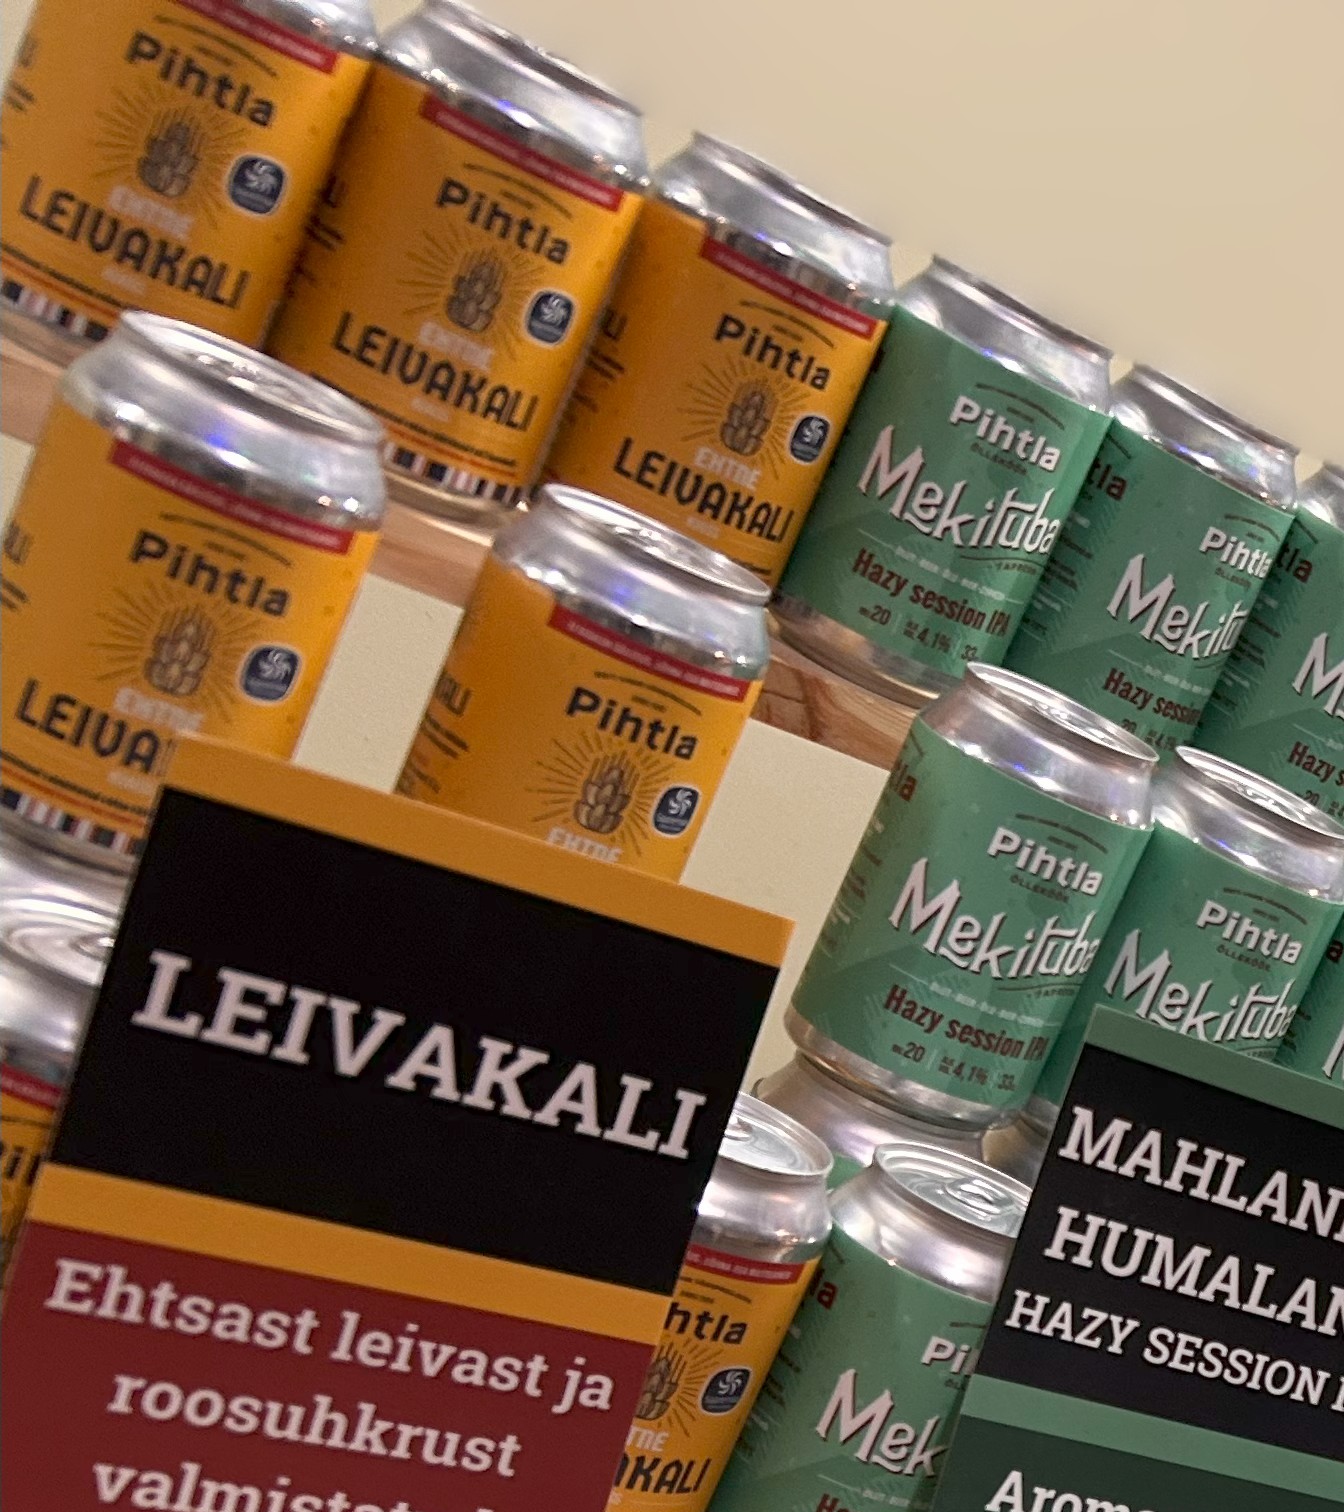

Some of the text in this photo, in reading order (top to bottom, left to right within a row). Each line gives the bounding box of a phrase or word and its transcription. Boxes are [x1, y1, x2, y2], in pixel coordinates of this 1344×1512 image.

[124, 29, 278, 128] Pihtla
[17, 172, 251, 311] LEIVAKALI
[434, 175, 573, 266] Pihtla
[330, 311, 540, 435] LEIVAKALI
[713, 313, 833, 393] Pihtla
[949, 394, 1063, 474] Pihtla
[612, 436, 797, 544] LEIVAKALI
[856, 423, 1065, 556] Mekituba
[129, 529, 292, 619] Pihtla
[851, 546, 986, 630] Hazy session
[1199, 524, 1274, 581] Pihtla
[564, 685, 700, 761] Pihtla
[1102, 666, 1154, 712] Hazy
[1286, 741, 1338, 786] Hazy
[986, 826, 1104, 897] Pihtla
[888, 857, 1099, 980] Mekituba
[1196, 900, 1302, 966] Pihtla
[131, 949, 707, 1160] LEIVAKALI
[883, 983, 1024, 1059] Hazy session
[44, 1257, 615, 1416] Ehtsast leivast ja
[1004, 1289, 1140, 1355] HAZY
[1143, 1326, 1333, 1405] SESSION
[107, 1372, 522, 1478] roosuhkrust
